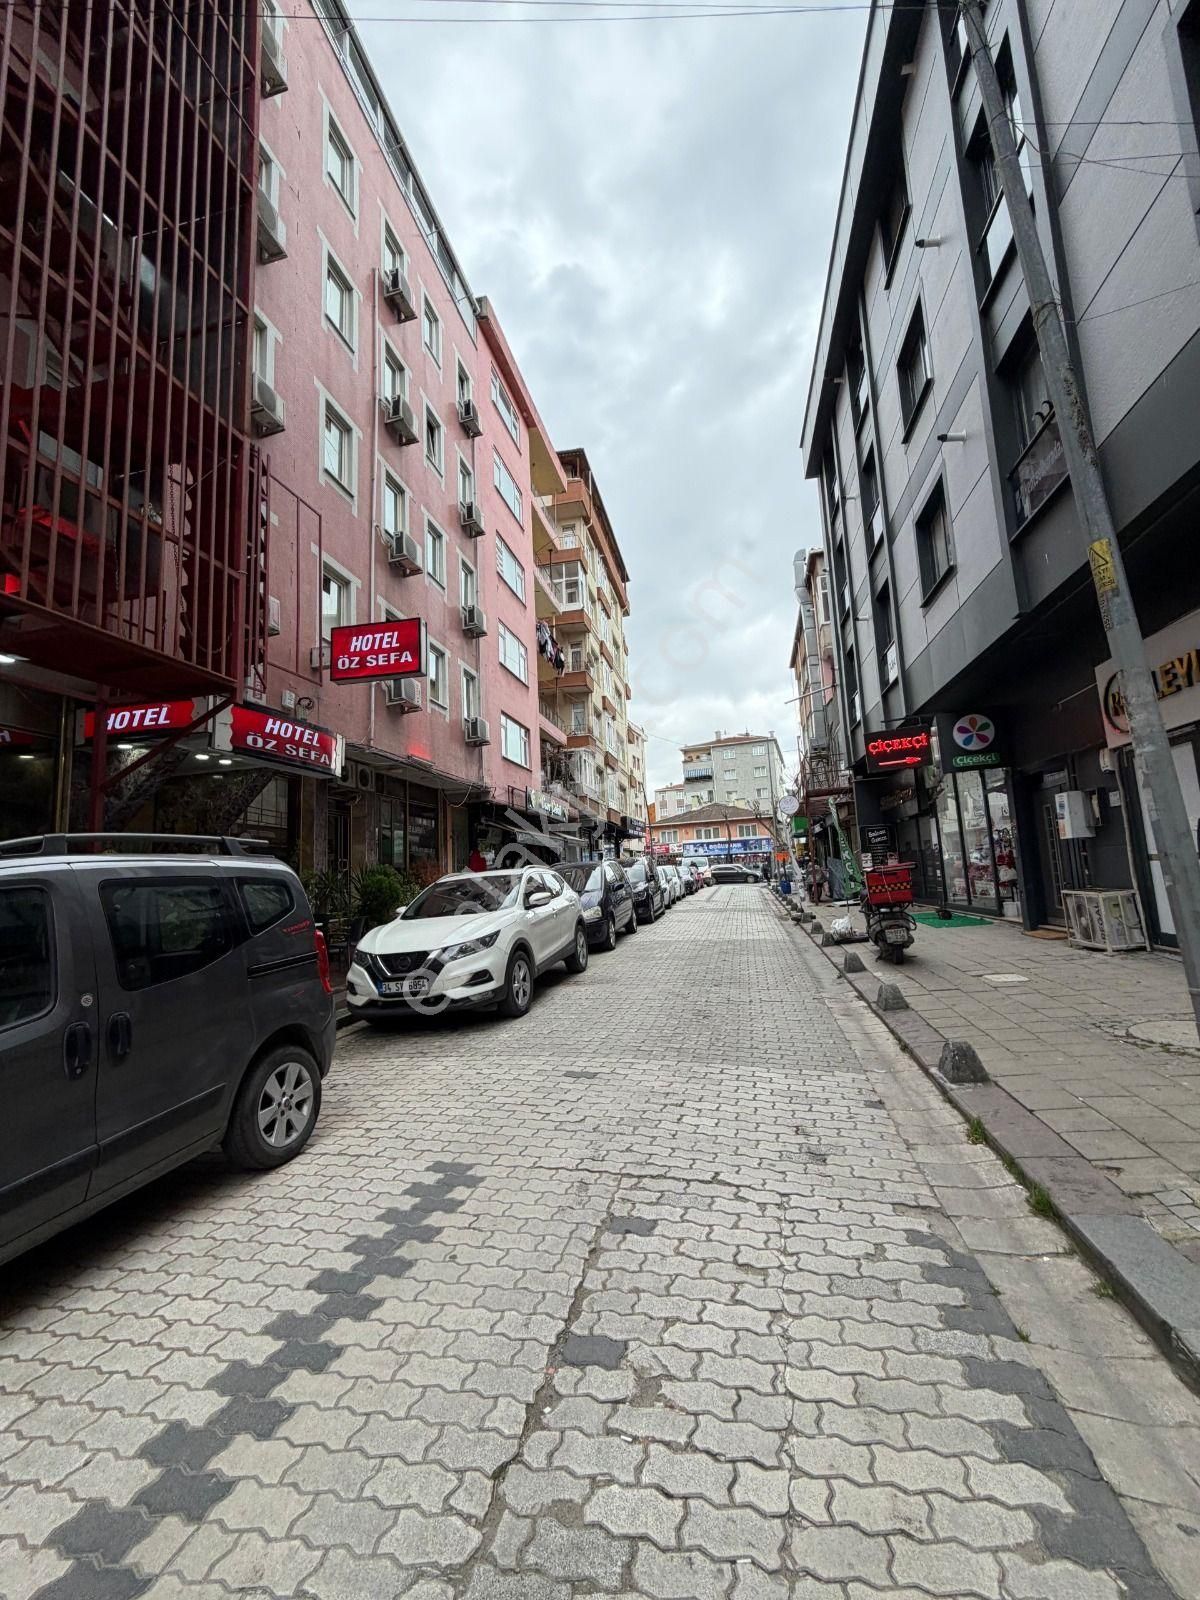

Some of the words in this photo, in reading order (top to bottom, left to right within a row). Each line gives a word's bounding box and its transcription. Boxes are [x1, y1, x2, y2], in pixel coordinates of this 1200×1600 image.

[350, 631, 400, 652] HOTEL
[338, 655, 360, 670] ÖZ
[366, 650, 413, 667] SEFA
[264, 718, 321, 747] HOTEL
[246, 731, 279, 752] ÖZ
[285, 744, 331, 765] SEFA
[868, 733, 928, 755] ÇİÇEKÇİ
[383, 983, 391, 992] 34
